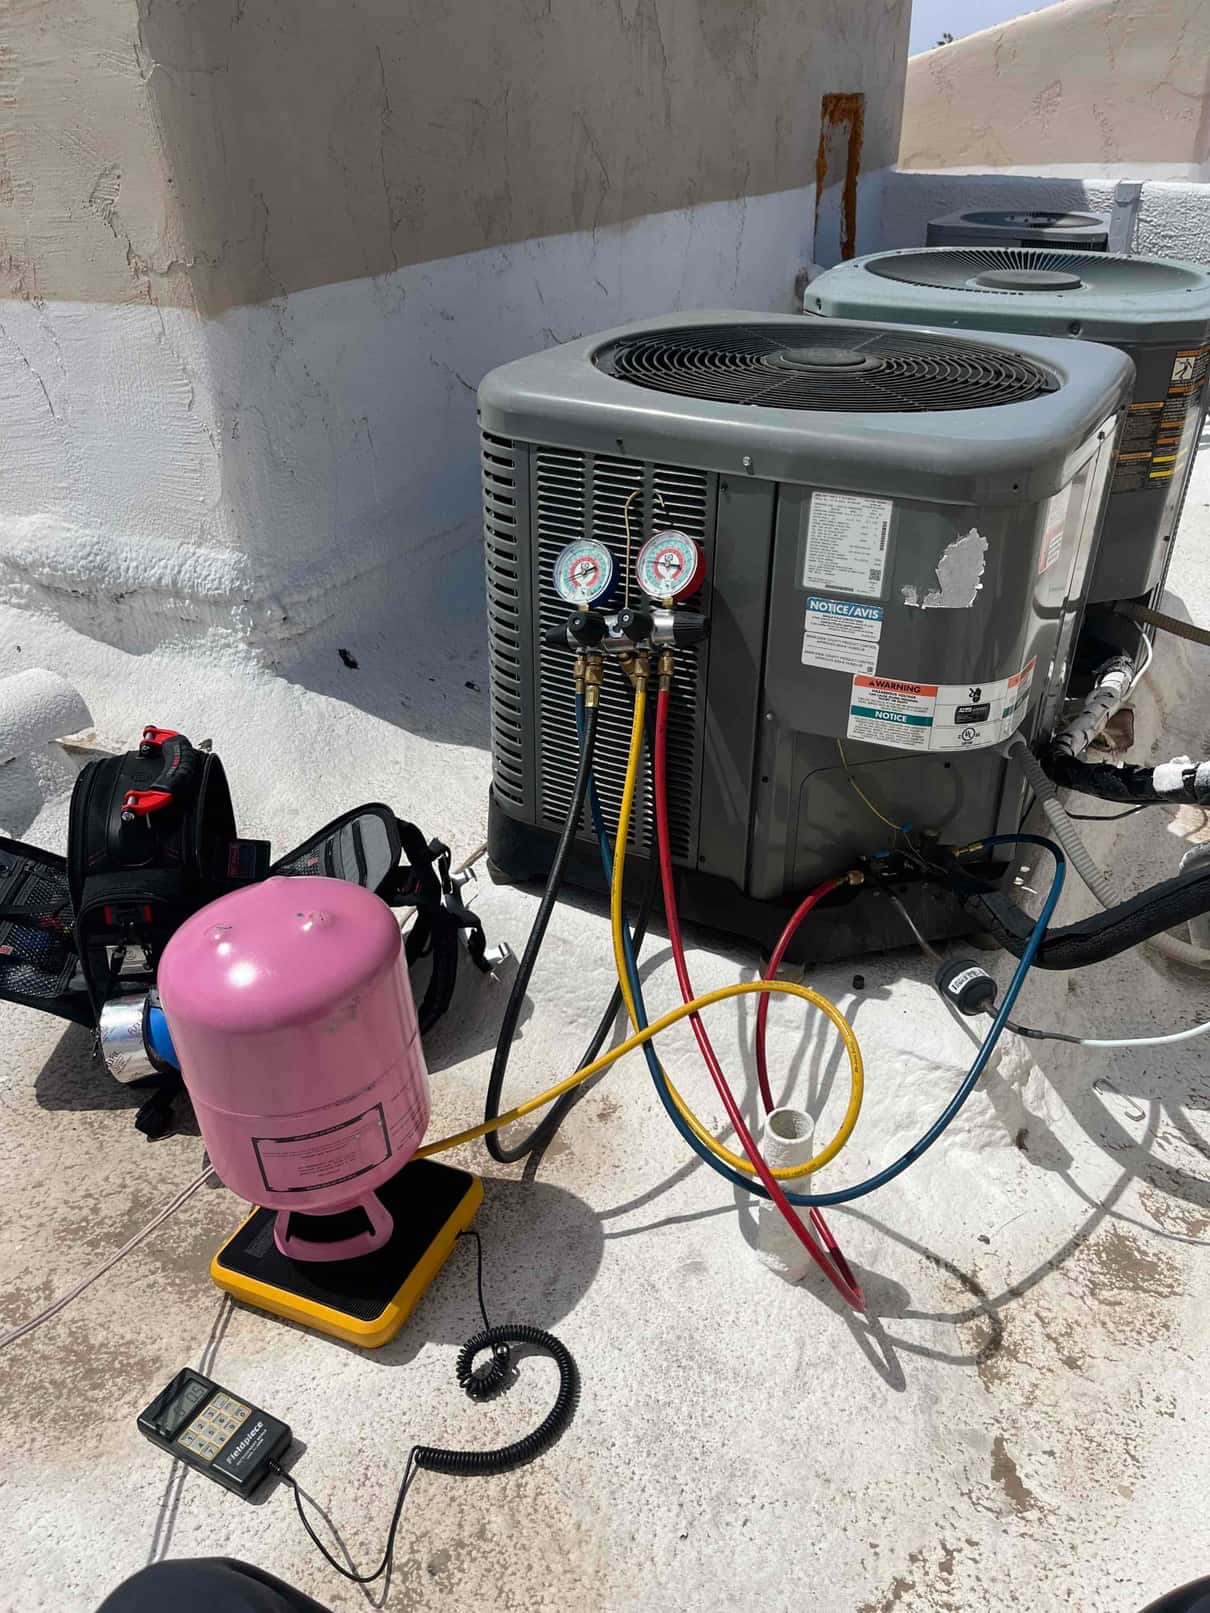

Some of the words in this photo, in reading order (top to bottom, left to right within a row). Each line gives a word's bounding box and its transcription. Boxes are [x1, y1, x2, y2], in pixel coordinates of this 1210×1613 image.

[810, 600, 880, 619] NOTICE/AVIS
[875, 680, 921, 694] WARNING
[875, 710, 908, 723] NOTICE
[226, 1421, 264, 1464] Fieldpiece
